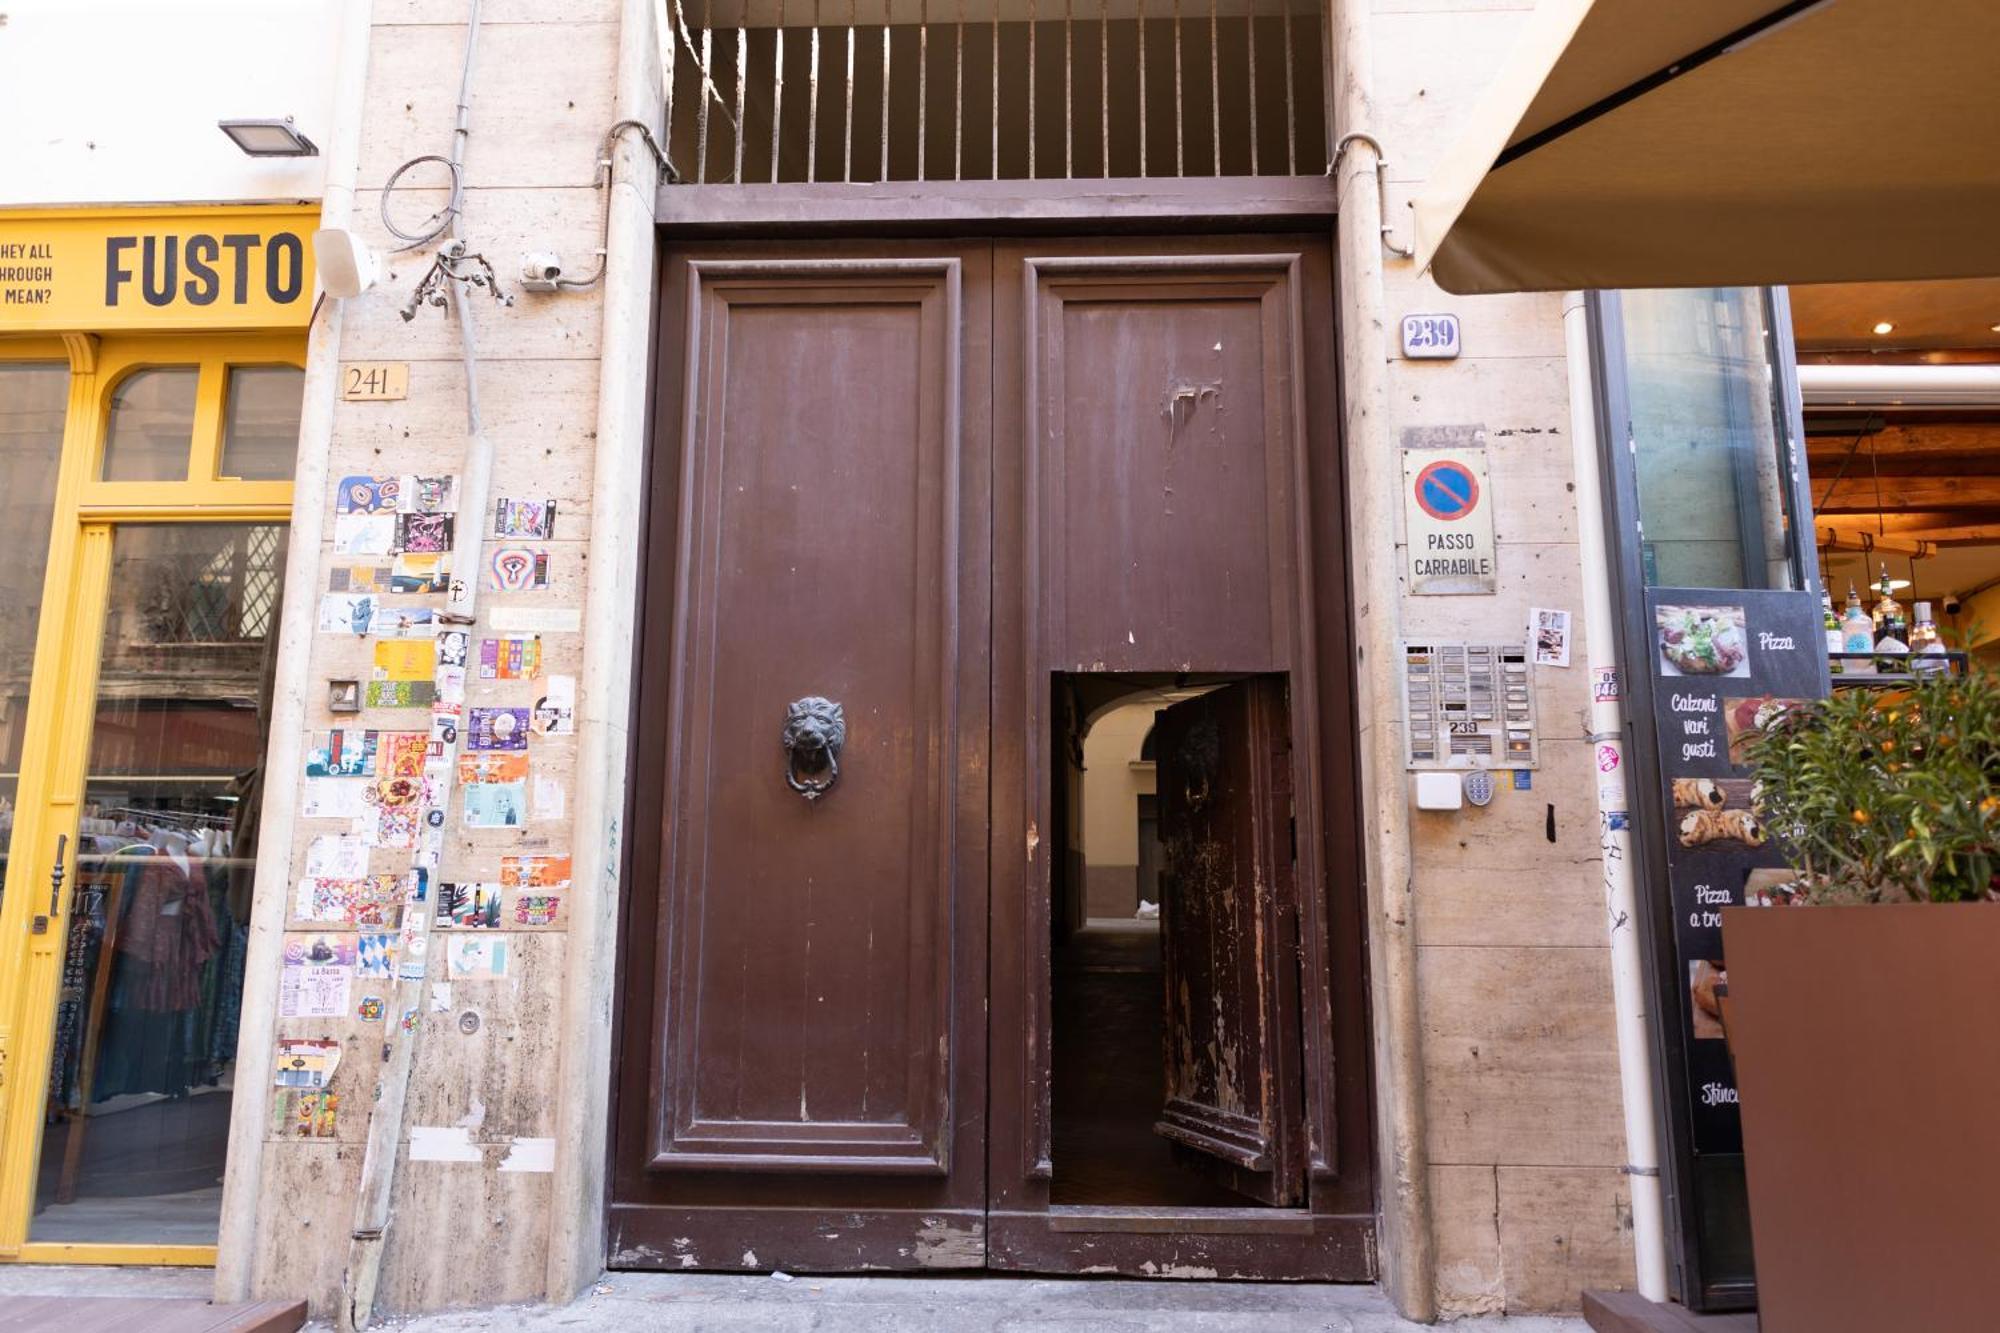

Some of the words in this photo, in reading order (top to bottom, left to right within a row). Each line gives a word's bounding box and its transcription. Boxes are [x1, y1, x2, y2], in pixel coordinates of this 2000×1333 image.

[29, 244, 52, 259] ALL
[105, 231, 303, 306] FUSTO
[5, 289, 52, 304] MEAN?
[1408, 319, 1454, 347] 239
[347, 368, 388, 394] 241
[1428, 533, 1474, 550] PASSO
[1415, 558, 1489, 576] CARRABILE
[1758, 632, 1795, 650] Pizza
[1671, 693, 1717, 712] Calzoni
[1450, 721, 1478, 733] 239
[1684, 716, 1710, 735] vari
[1682, 738, 1716, 761] gusti
[1694, 884, 1733, 904] Pizza
[1690, 912, 1701, 927] a
